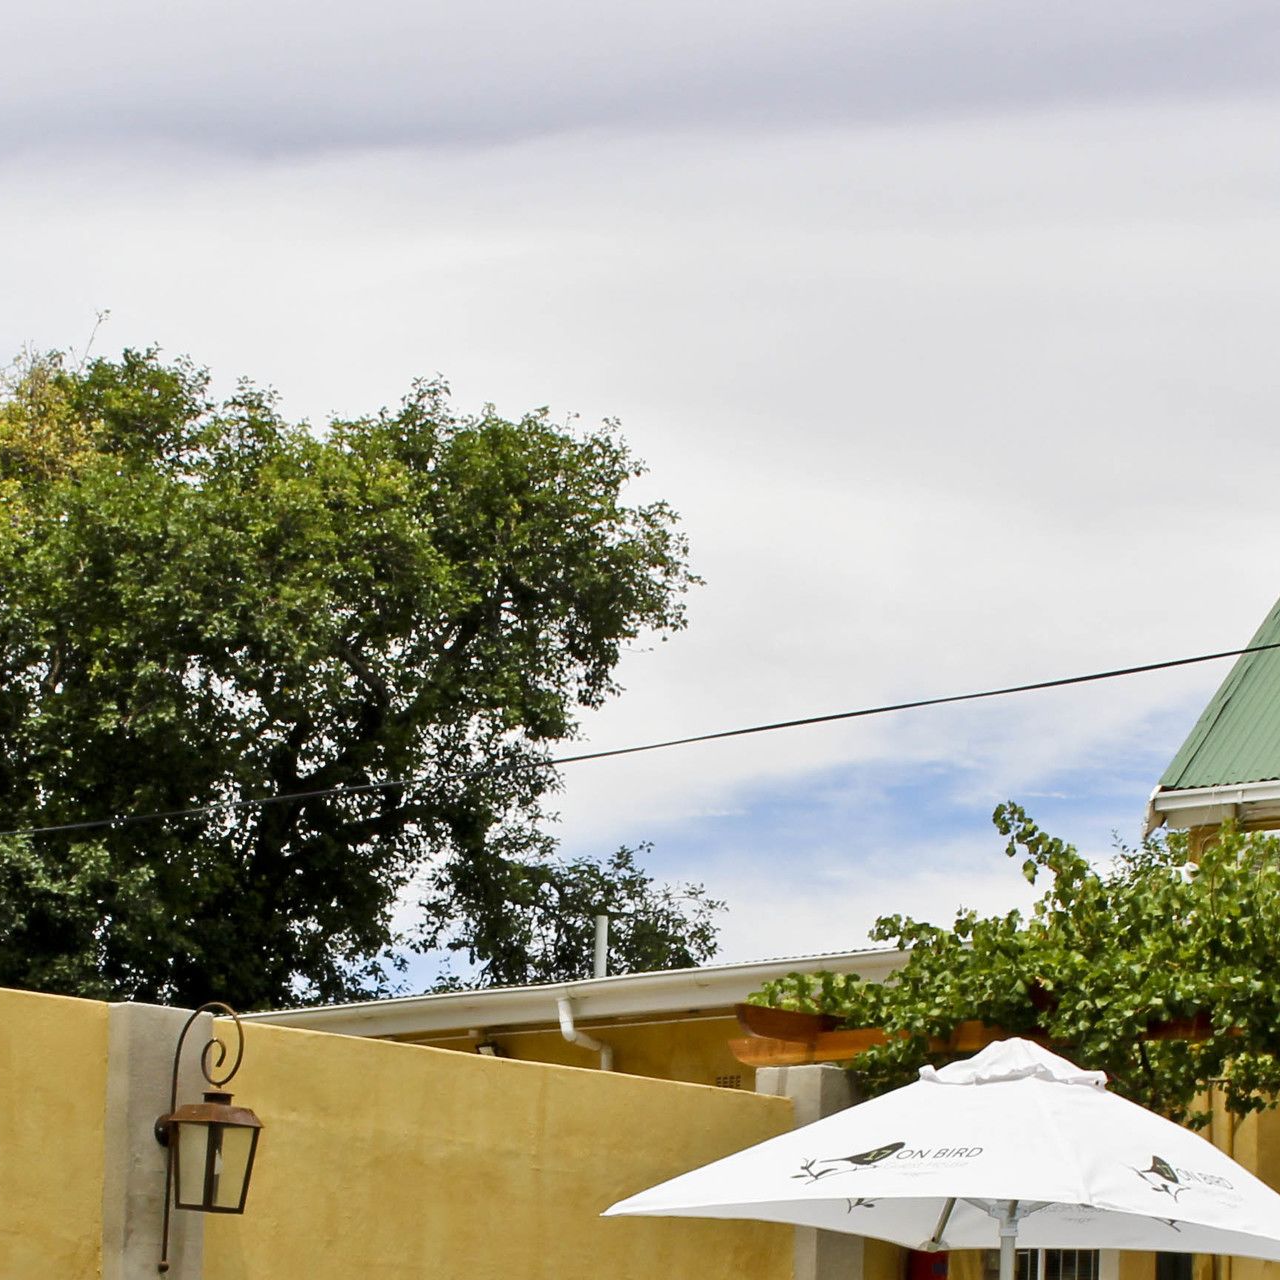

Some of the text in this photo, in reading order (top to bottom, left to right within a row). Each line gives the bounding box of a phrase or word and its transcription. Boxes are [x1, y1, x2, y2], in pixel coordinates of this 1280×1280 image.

[863, 1147, 983, 1161] 17 ON BIRD
